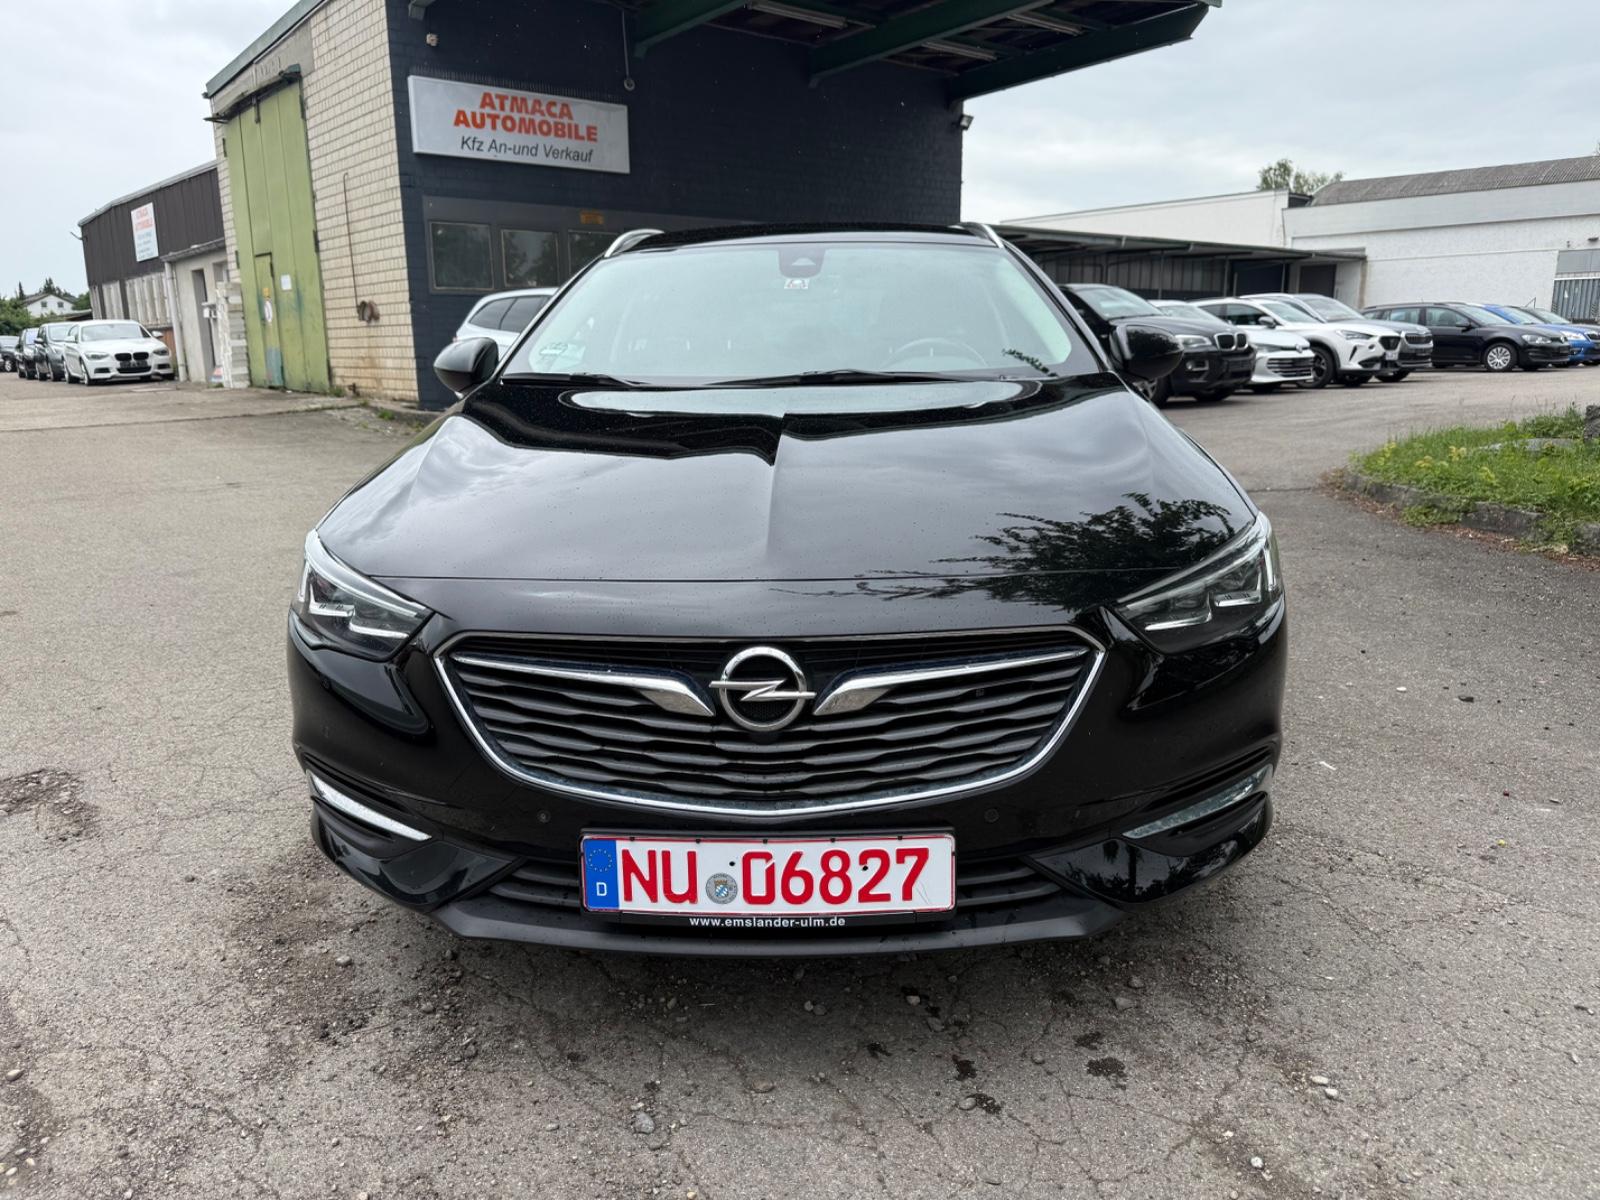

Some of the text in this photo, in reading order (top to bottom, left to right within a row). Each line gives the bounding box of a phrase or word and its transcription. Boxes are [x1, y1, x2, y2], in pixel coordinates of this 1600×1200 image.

[479, 91, 574, 120] ATMACA
[454, 109, 598, 142] AUTOMOBILE
[460, 136, 594, 163] Kfz An-und Verkauf
[596, 882, 607, 897] D
[621, 847, 930, 906] NU 06827
[689, 916, 846, 928] www.emslander-ulm.de
